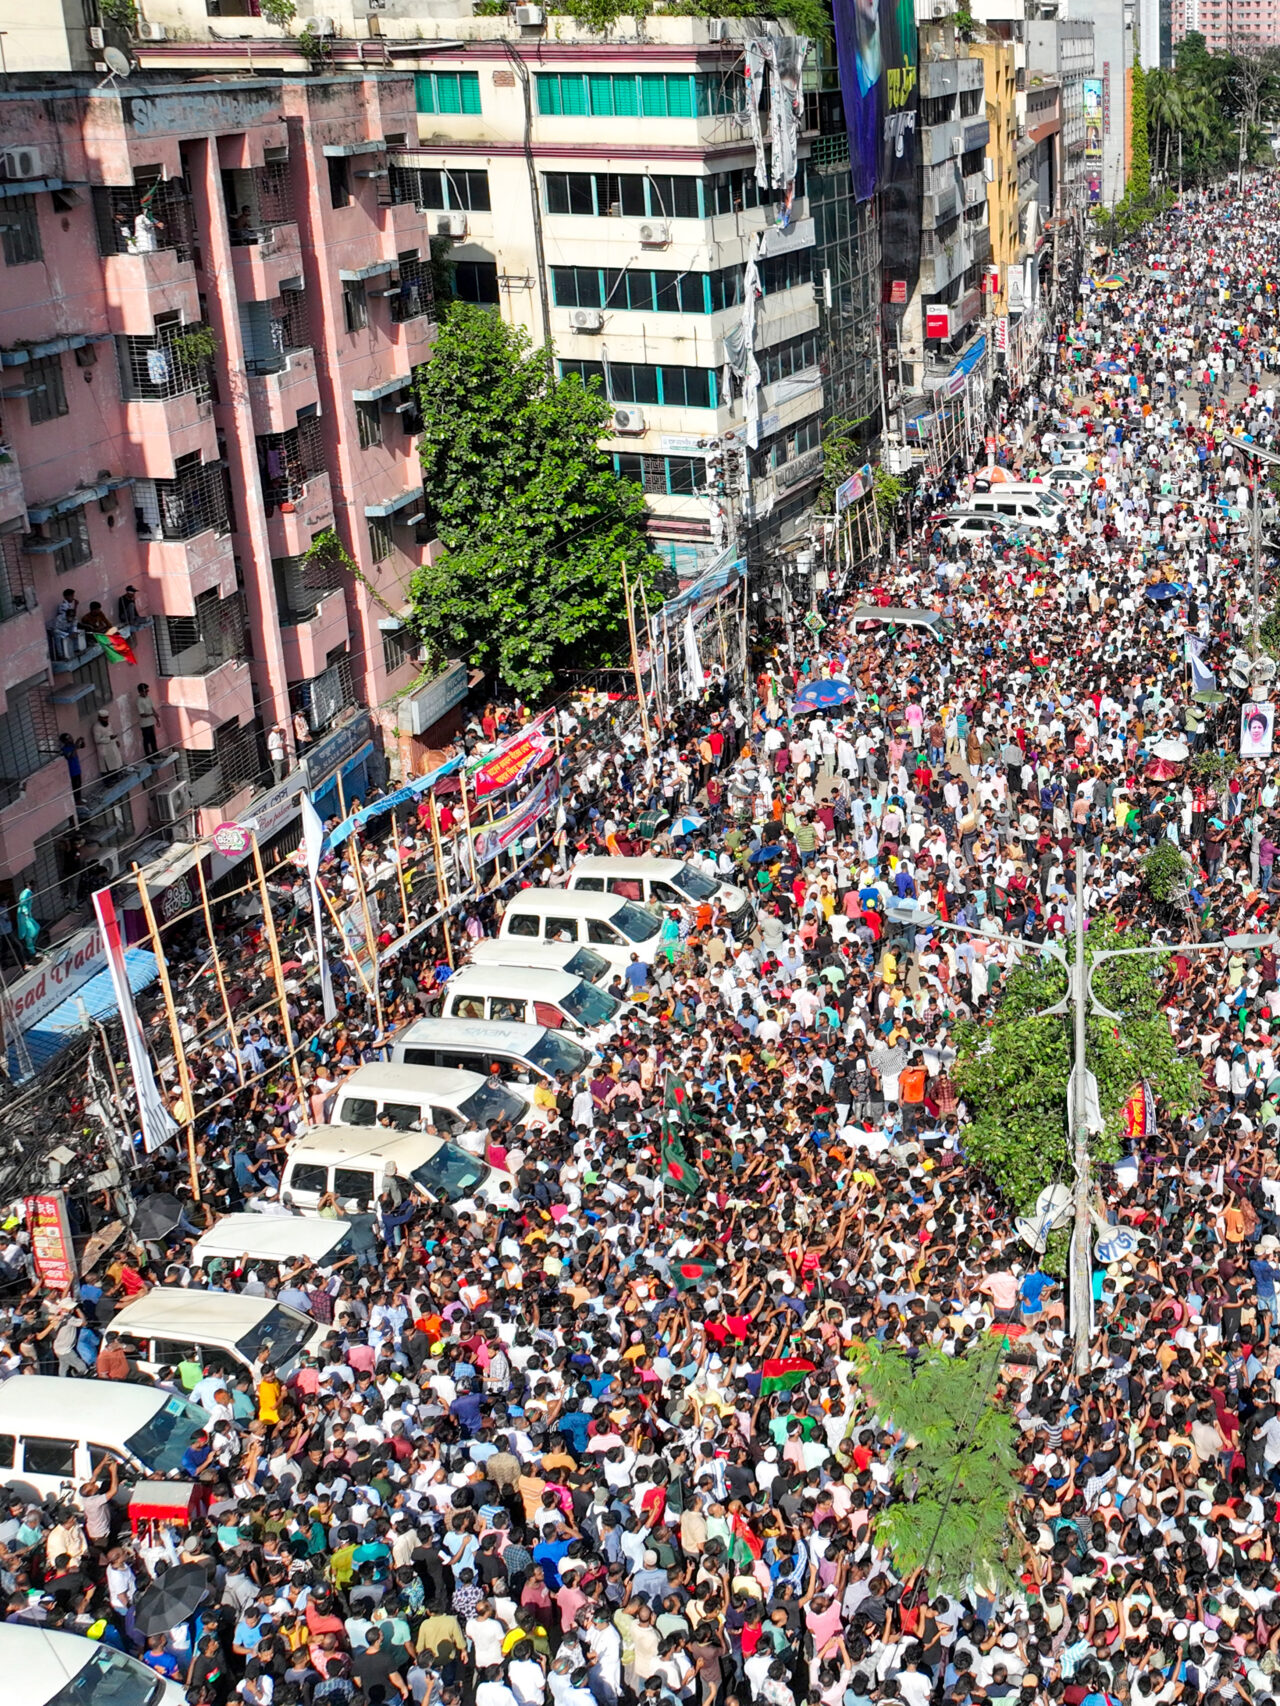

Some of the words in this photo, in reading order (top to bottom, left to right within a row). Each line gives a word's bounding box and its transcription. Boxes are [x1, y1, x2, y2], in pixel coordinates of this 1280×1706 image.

[998, 320, 1006, 350] Bata
[51, 929, 106, 984] Tradi
[465, 1028, 512, 1037] NEWS
